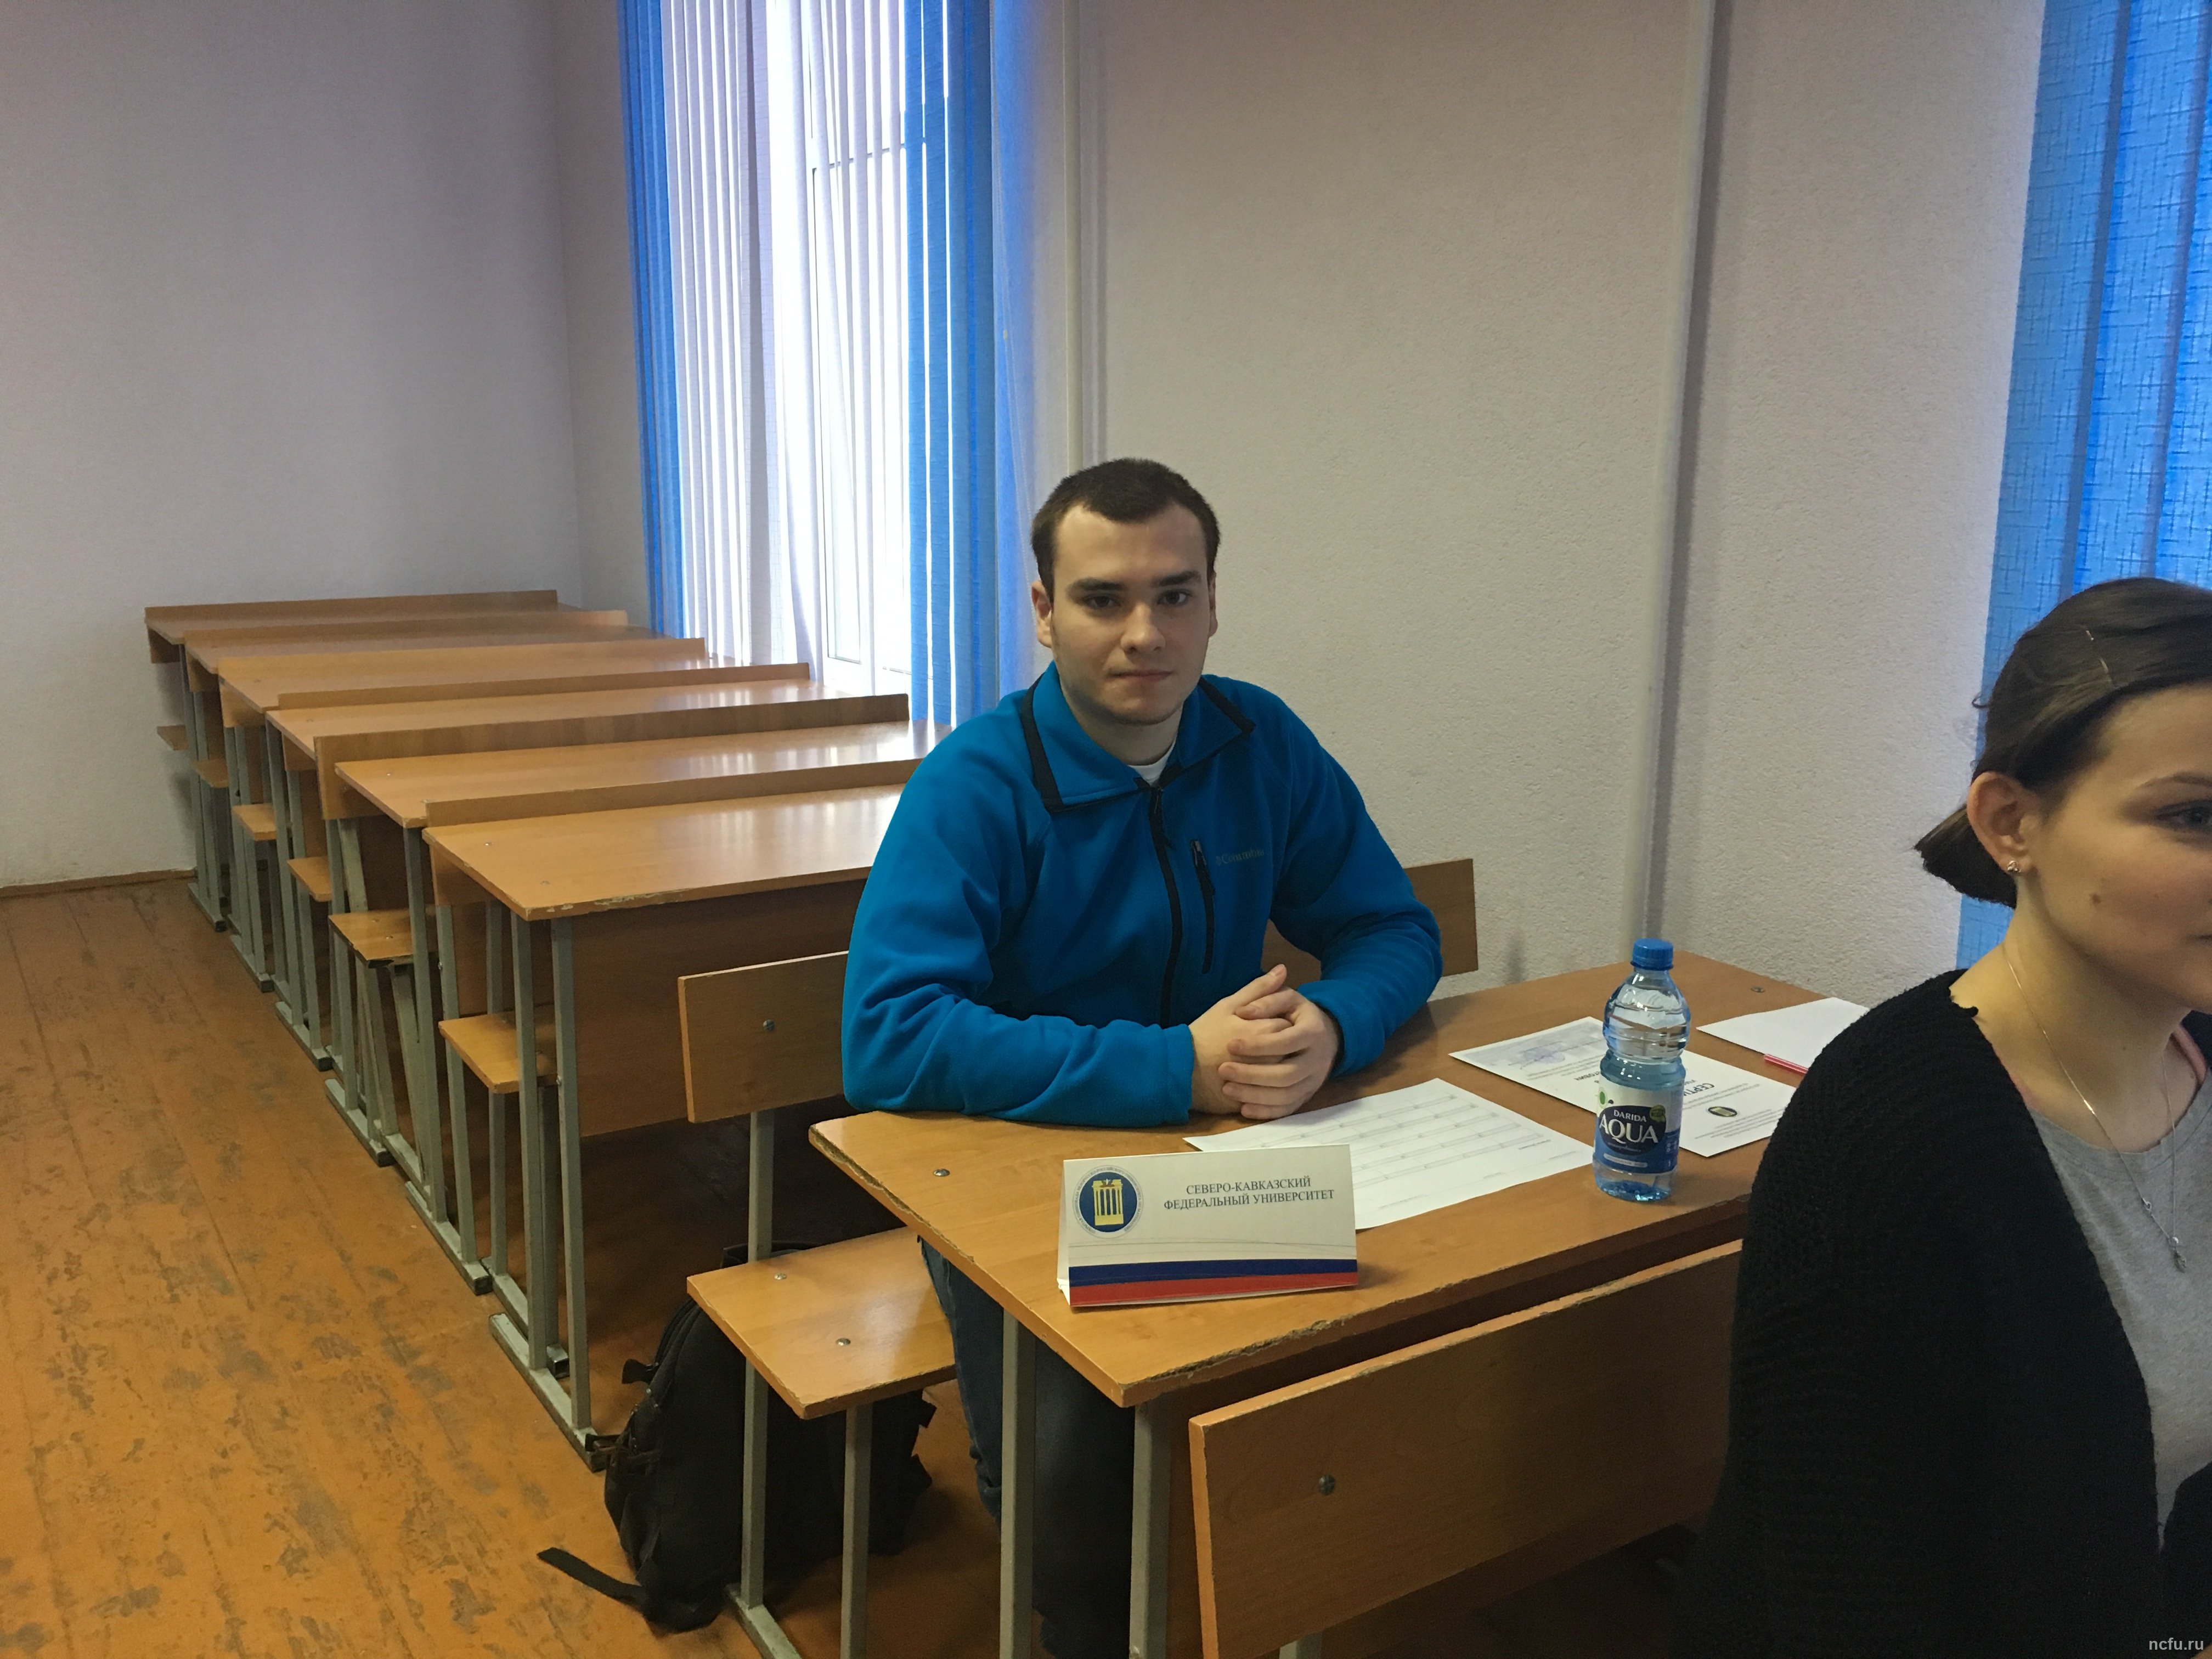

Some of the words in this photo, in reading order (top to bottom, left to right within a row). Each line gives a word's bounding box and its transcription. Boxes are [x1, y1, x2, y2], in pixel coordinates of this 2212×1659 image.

[1613, 1109, 1646, 1122] DARIDA
[1599, 1114, 1659, 1144] AQUA
[1186, 1175, 1311, 1195] СЕВЕРО-КАВКАЗСКИЙ
[1164, 1193, 1250, 1210] ФЕДЕРАЛЬНЫЙ
[1253, 1189, 1335, 1204] УНИВЕРСИТЕТ
